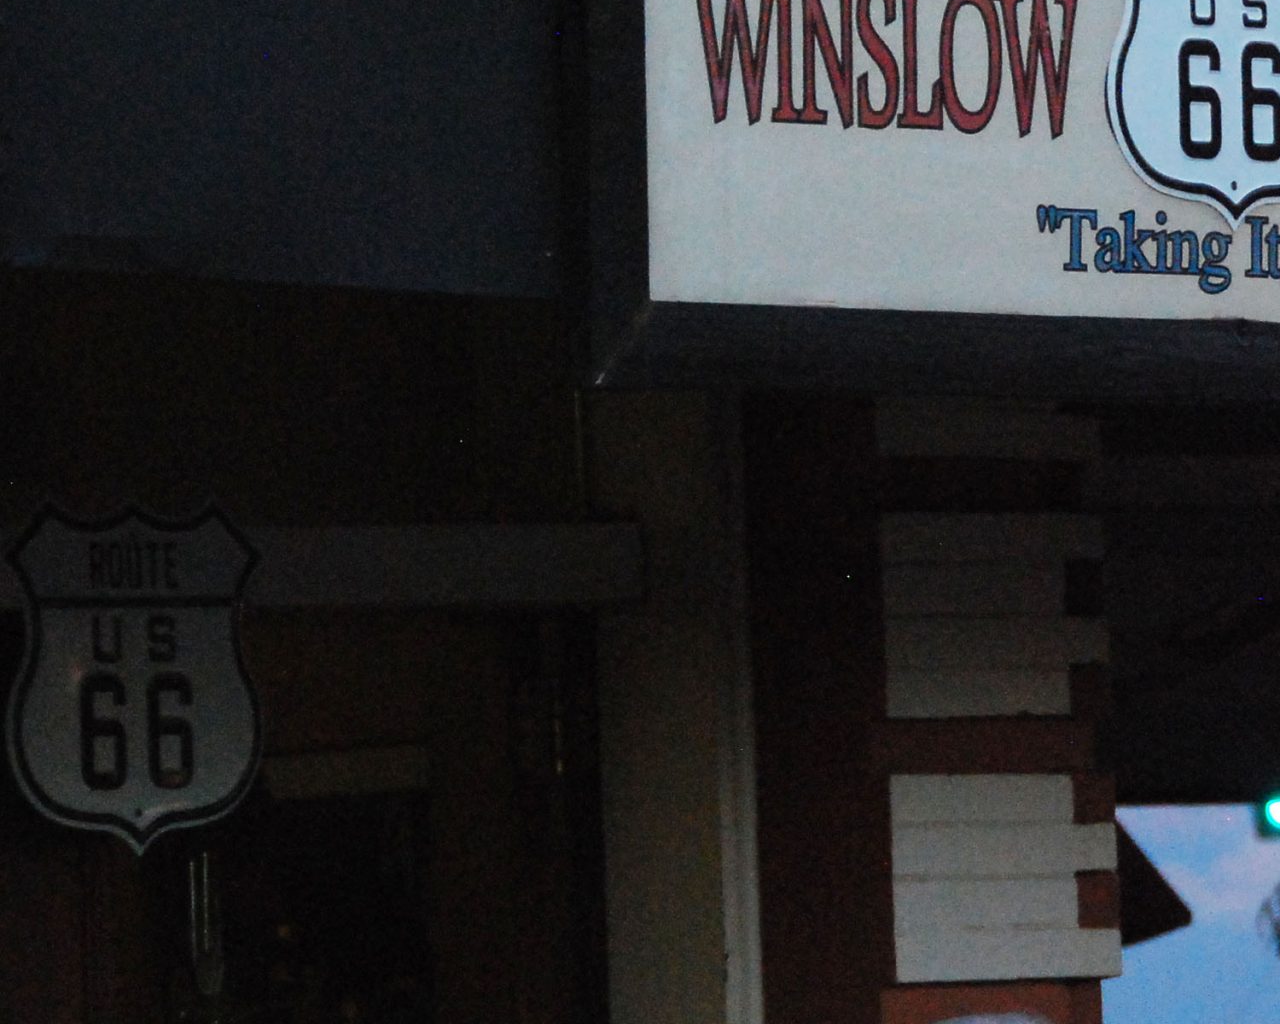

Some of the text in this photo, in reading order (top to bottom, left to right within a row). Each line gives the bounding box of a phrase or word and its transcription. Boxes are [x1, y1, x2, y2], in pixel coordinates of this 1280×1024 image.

[1036, 204, 1233, 294] "Taking
[89, 540, 179, 591] ROUTE
[81, 672, 195, 791] 66
